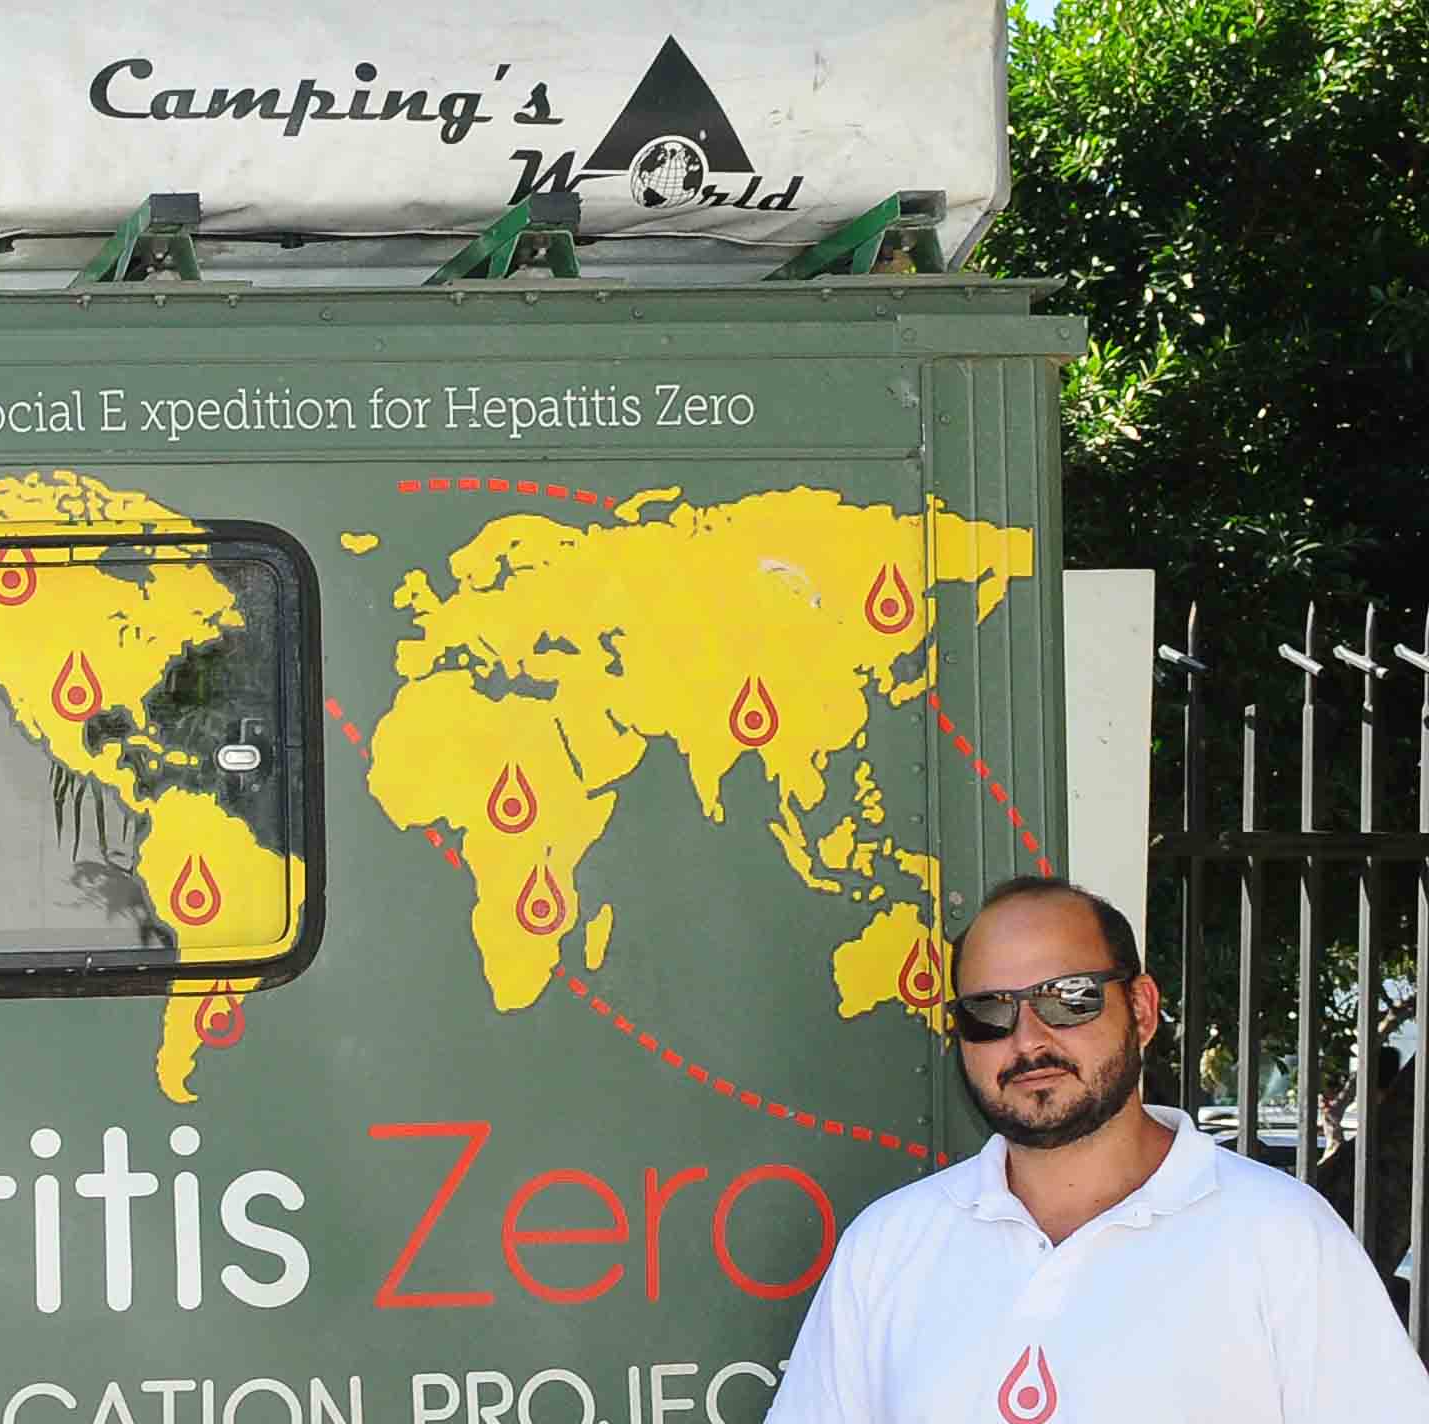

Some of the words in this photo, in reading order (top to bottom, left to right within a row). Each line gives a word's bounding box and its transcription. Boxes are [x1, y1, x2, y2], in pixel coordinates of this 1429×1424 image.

[89, 57, 564, 144] Camping's
[369, 387, 427, 431] for
[444, 386, 643, 430] Hepatitis
[655, 386, 755, 427] Zero
[368, 1120, 837, 1308] Zero
